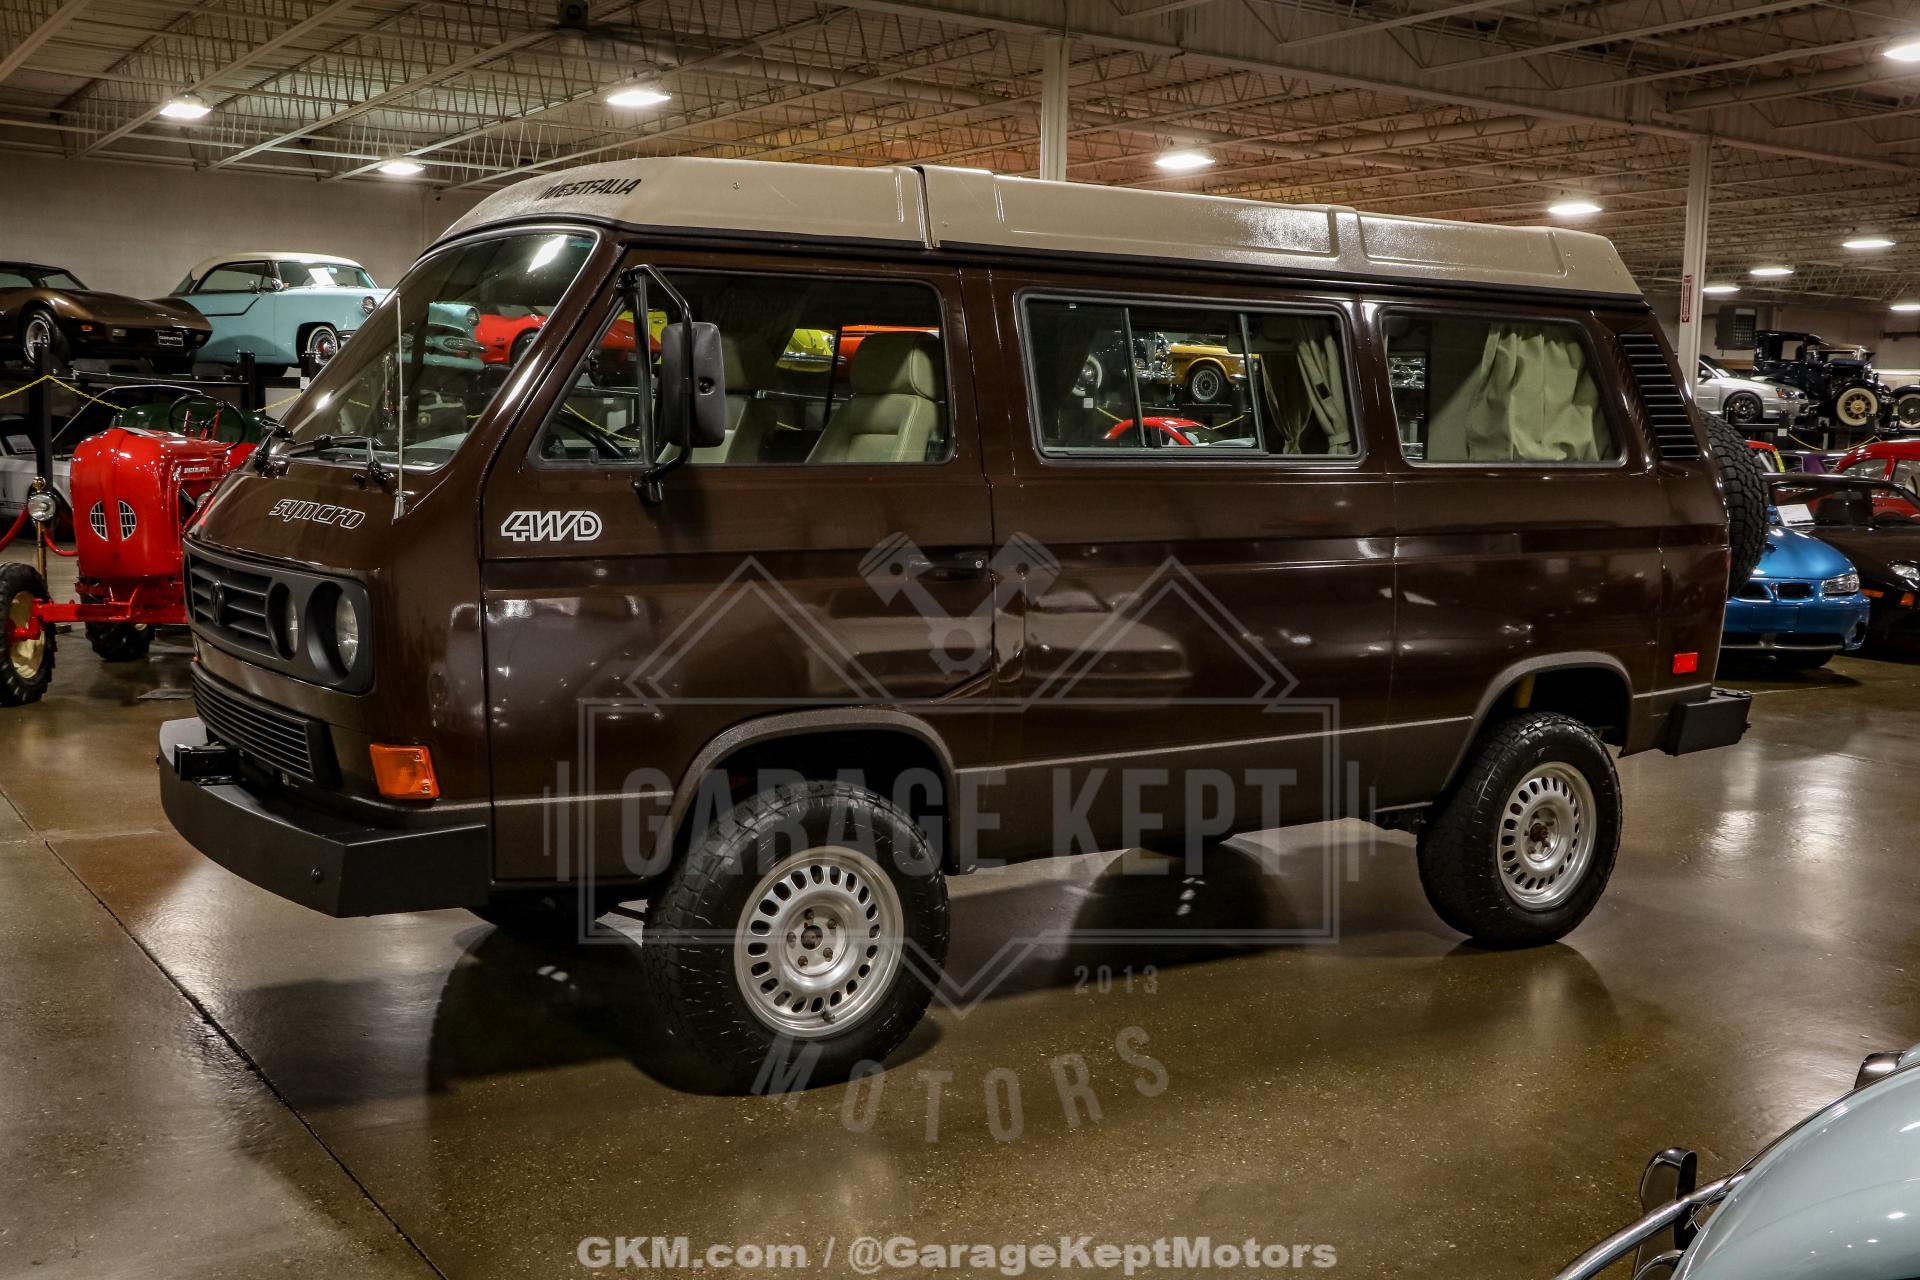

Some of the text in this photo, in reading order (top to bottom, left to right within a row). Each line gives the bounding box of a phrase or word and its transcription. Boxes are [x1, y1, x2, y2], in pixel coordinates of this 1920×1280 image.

[535, 179, 642, 201] WESTFALIA
[268, 499, 366, 529] syncro
[501, 510, 603, 542] 4WD
